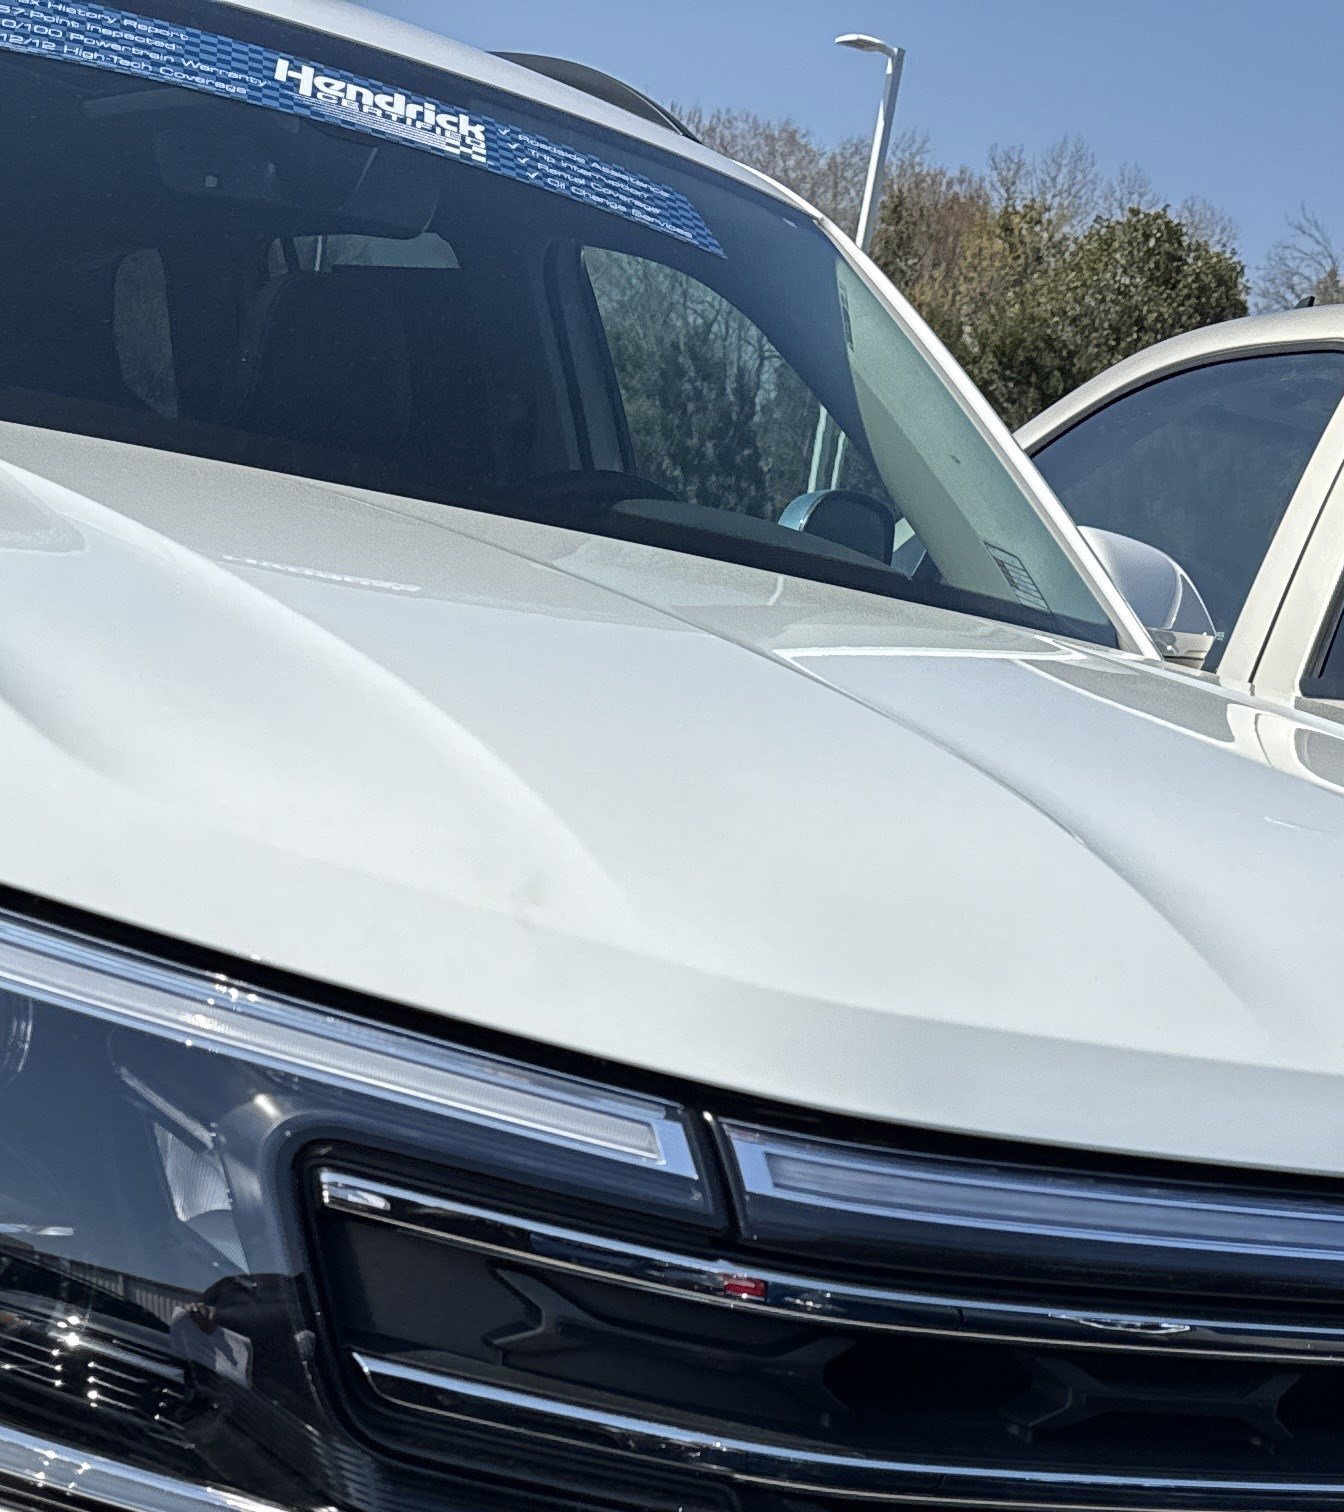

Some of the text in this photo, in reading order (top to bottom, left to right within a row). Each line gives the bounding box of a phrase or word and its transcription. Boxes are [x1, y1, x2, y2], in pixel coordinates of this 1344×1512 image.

[47, 1, 117, 24] History
[123, 18, 189, 41] Report
[69, 31, 175, 63] Powertrain
[0, 33, 248, 94] 12/12 High-Tech Coverage
[274, 58, 485, 139] Hendrick
[316, 91, 486, 149] CERTIFIED
[518, 133, 671, 198] Roadside Assistance
[570, 185, 627, 212] Change
[631, 208, 694, 239] Services
[590, 181, 662, 214] Coverage
